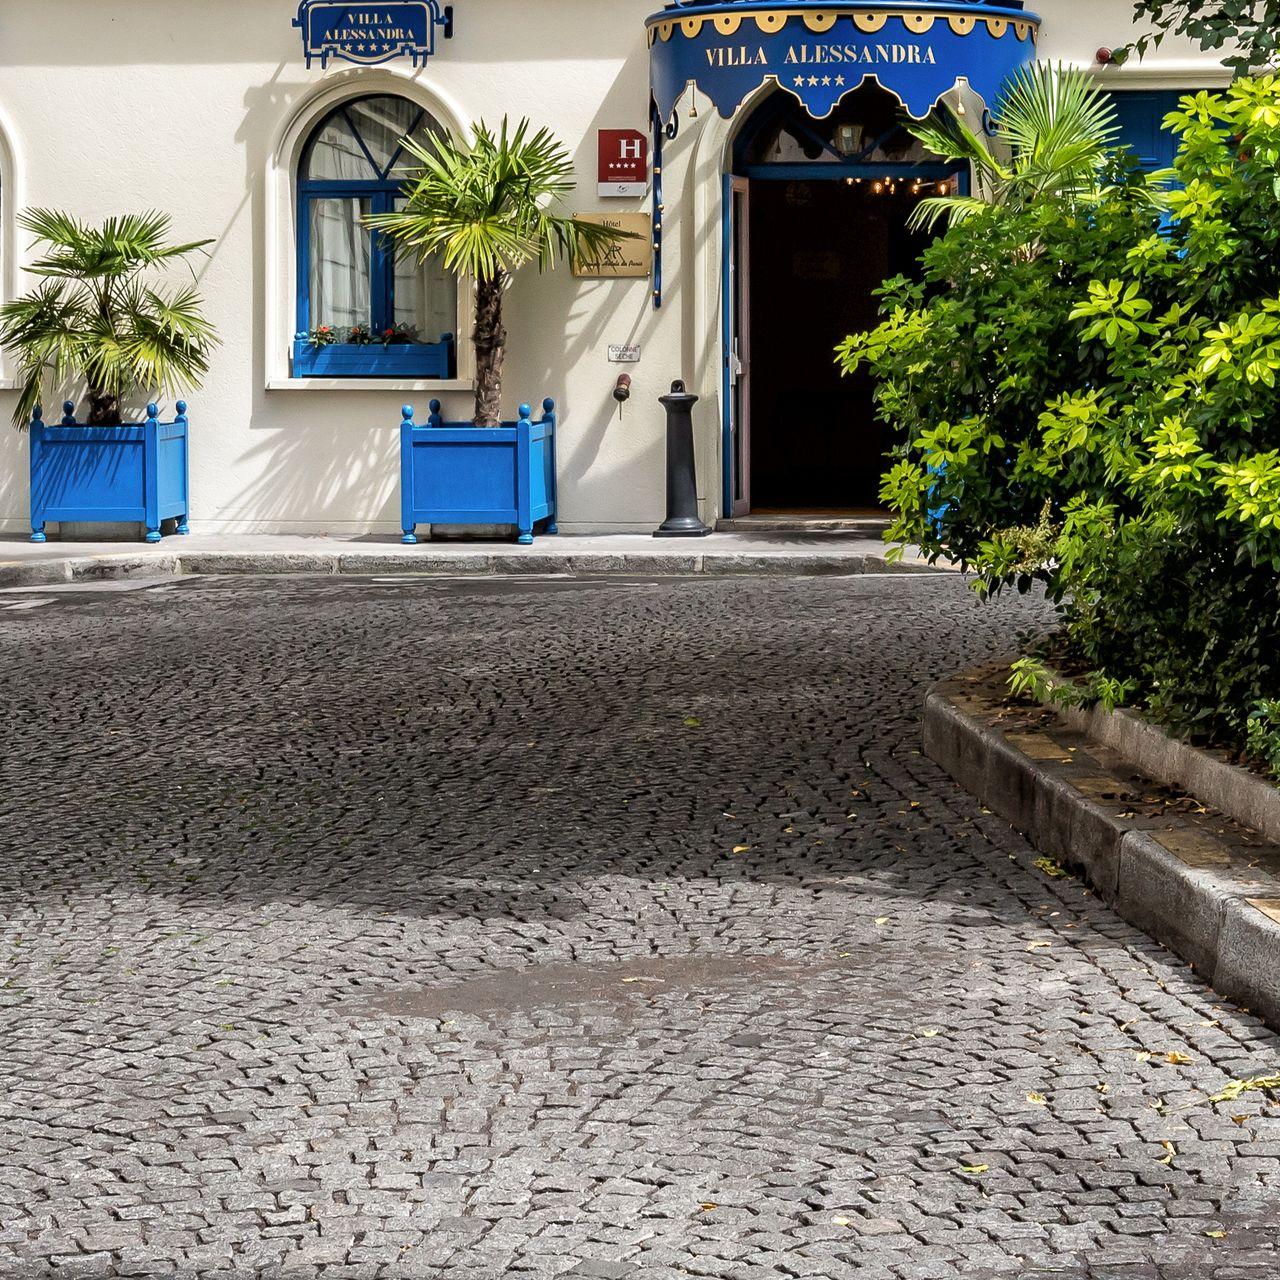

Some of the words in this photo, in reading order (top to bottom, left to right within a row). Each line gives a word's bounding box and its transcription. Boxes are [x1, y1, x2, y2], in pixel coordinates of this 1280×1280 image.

[348, 13, 393, 24] VILLA
[323, 28, 415, 40] ALESSANDRA
[705, 46, 768, 67] VILLA
[783, 44, 936, 64] ALESSANDRA
[619, 138, 642, 159] H
